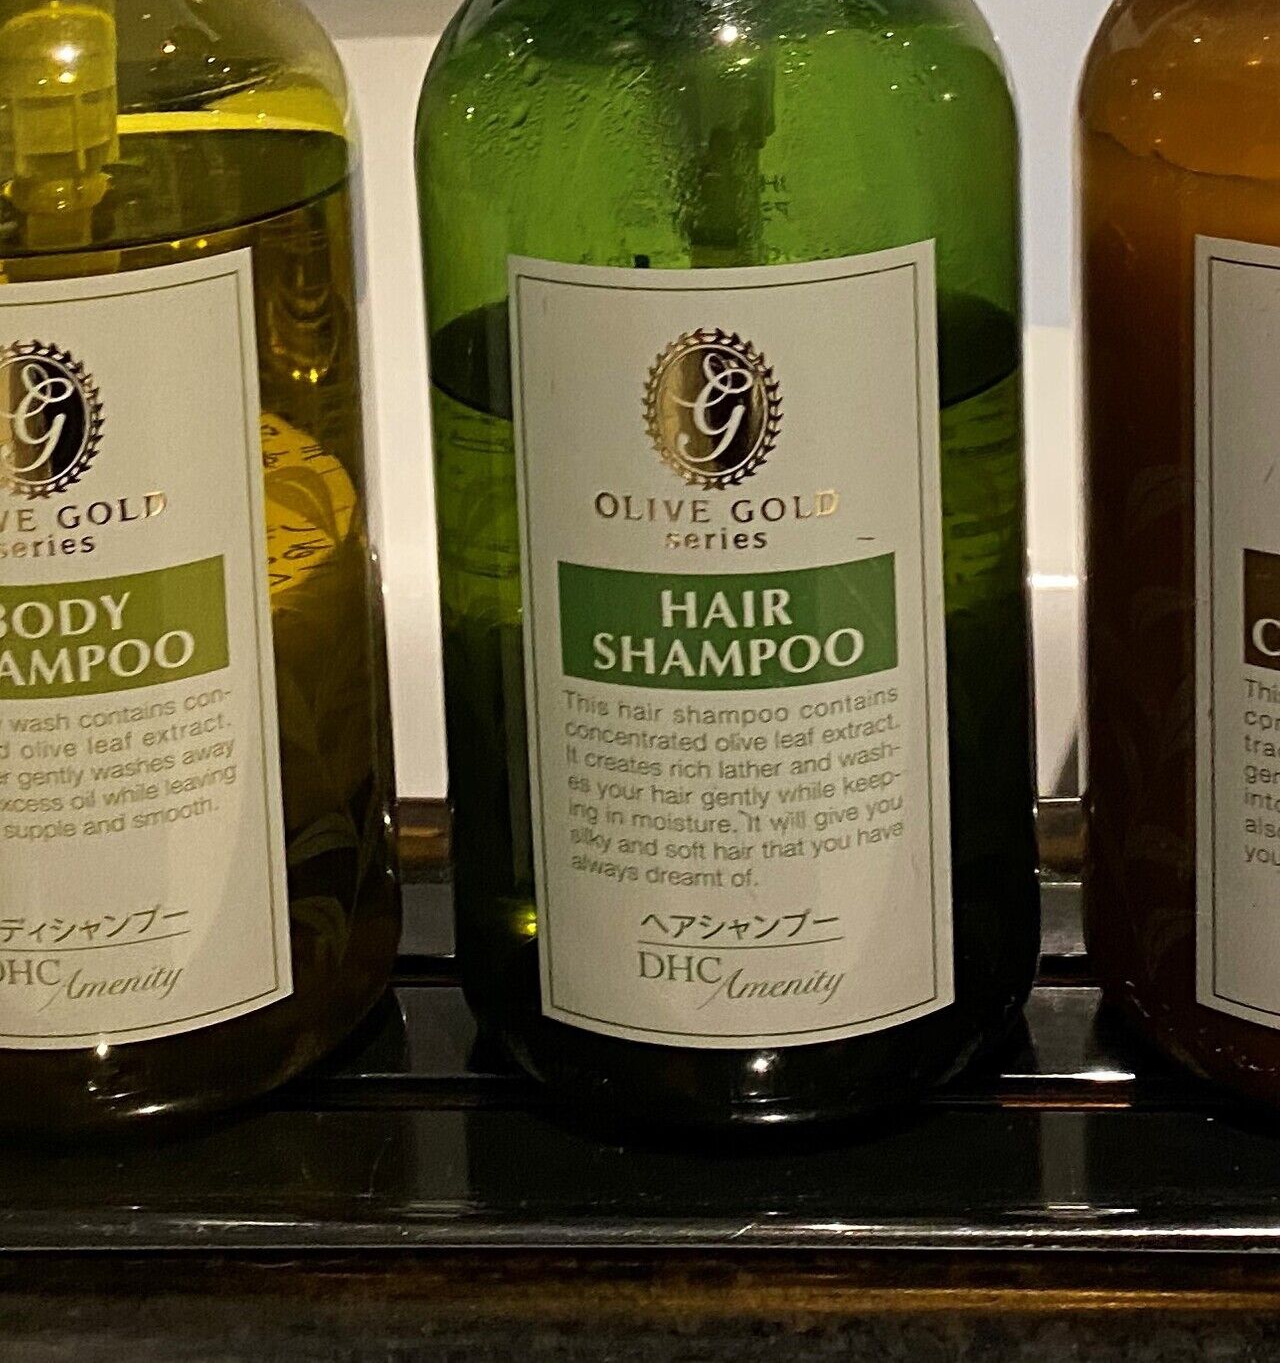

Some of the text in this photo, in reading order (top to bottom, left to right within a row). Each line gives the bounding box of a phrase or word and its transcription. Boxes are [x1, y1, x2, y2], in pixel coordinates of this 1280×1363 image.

[57, 491, 167, 530] GOLD
[595, 489, 840, 524] OLIVE GOLD
[666, 528, 768, 550] series
[660, 588, 793, 629] HAIR
[592, 628, 865, 678] SHAMPOO
[9, 712, 70, 732] wash
[80, 700, 176, 730] contains
[183, 688, 231, 711] con-
[562, 687, 898, 728] This hair shampoo contains
[20, 739, 77, 759] olive
[88, 731, 132, 755] leaf
[142, 713, 231, 747] extract.
[565, 721, 707, 752] concentrated
[715, 732, 767, 752] olive
[775, 727, 814, 748] leaf
[18, 766, 84, 791] gently
[90, 755, 175, 782] washes
[182, 739, 235, 765] away
[566, 741, 902, 779] It creates rich lather and wash-
[71, 788, 95, 810] oil
[102, 784, 159, 806] while
[165, 765, 237, 796] leaving
[568, 771, 901, 811] es your hair gently while keep-
[4, 819, 77, 842] supple
[83, 813, 125, 836] and
[133, 796, 219, 828] smooth.
[569, 799, 598, 825] ing
[606, 808, 623, 825] in
[632, 812, 738, 834] moisture.
[769, 810, 806, 832] will
[814, 807, 859, 831] give
[866, 795, 903, 822] you
[570, 821, 903, 861] silky and soft hair that you have
[571, 853, 759, 888] always dreamt of.
[641, 908, 839, 939] ヘアシャンプー
[37, 965, 184, 1013] Amenity
[637, 950, 845, 1010] DHC Amenity
